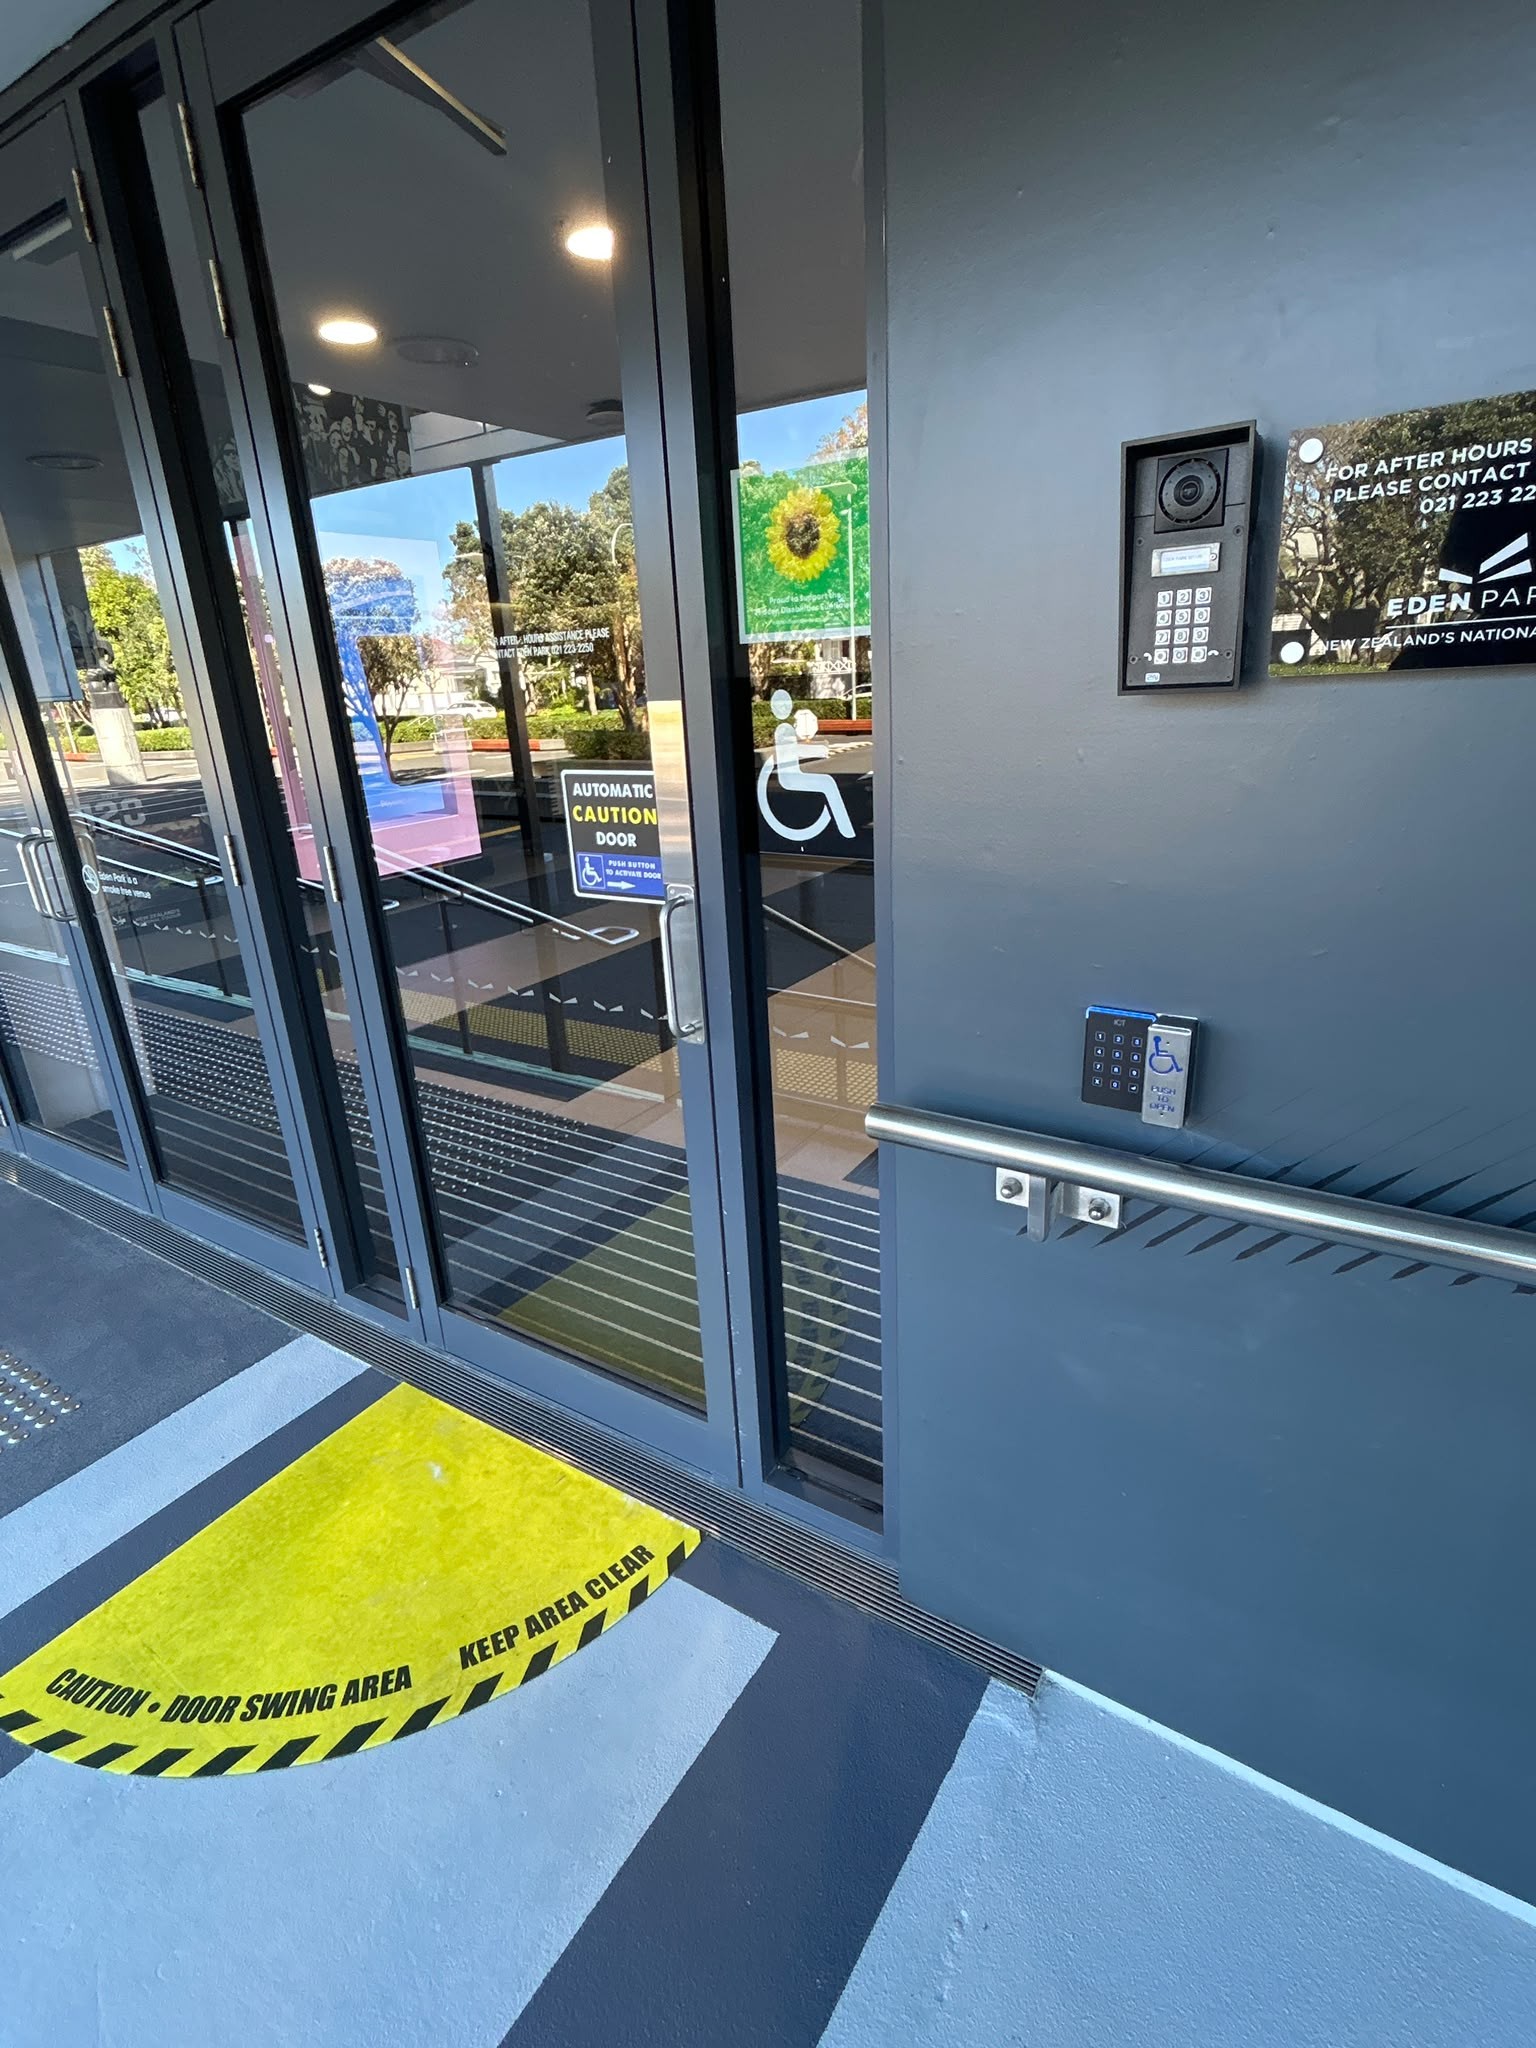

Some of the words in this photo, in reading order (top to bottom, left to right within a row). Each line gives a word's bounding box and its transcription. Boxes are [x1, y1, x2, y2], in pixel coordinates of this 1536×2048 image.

[1325, 463, 1367, 482] FOR
[1374, 451, 1444, 476] AFTER
[1451, 437, 1533, 465] HOURS
[1333, 479, 1413, 504] PLEASE
[1418, 462, 1531, 492] CONTACT
[1420, 494, 1455, 514] 021
[1462, 489, 1503, 509] 223
[1508, 484, 1536, 503] 22
[1387, 592, 1470, 617] EDEN
[585, 627, 610, 639] PLEASE
[1321, 638, 1356, 652] NEW
[1360, 631, 1455, 650] ZEALAND'S
[573, 783, 654, 798] AUTOMATIC
[572, 805, 657, 825] CAUTION
[596, 831, 637, 847] DOOR
[615, 869, 642, 878] ACTIVATE
[644, 871, 662, 879] DOOR
[628, 861, 656, 869] BUTTON
[1151, 1085, 1176, 1096] PUSH
[1157, 1094, 1169, 1103] TO
[1149, 1103, 1175, 1113] OPEN
[459, 1624, 519, 1670] KEEP
[524, 1590, 589, 1640] AREA
[584, 1544, 655, 1600] CLEAR
[45, 1668, 151, 1718] CAUTION
[160, 1694, 241, 1724] DOOR
[240, 1683, 339, 1722] SWING
[341, 1665, 413, 1707] AREA
